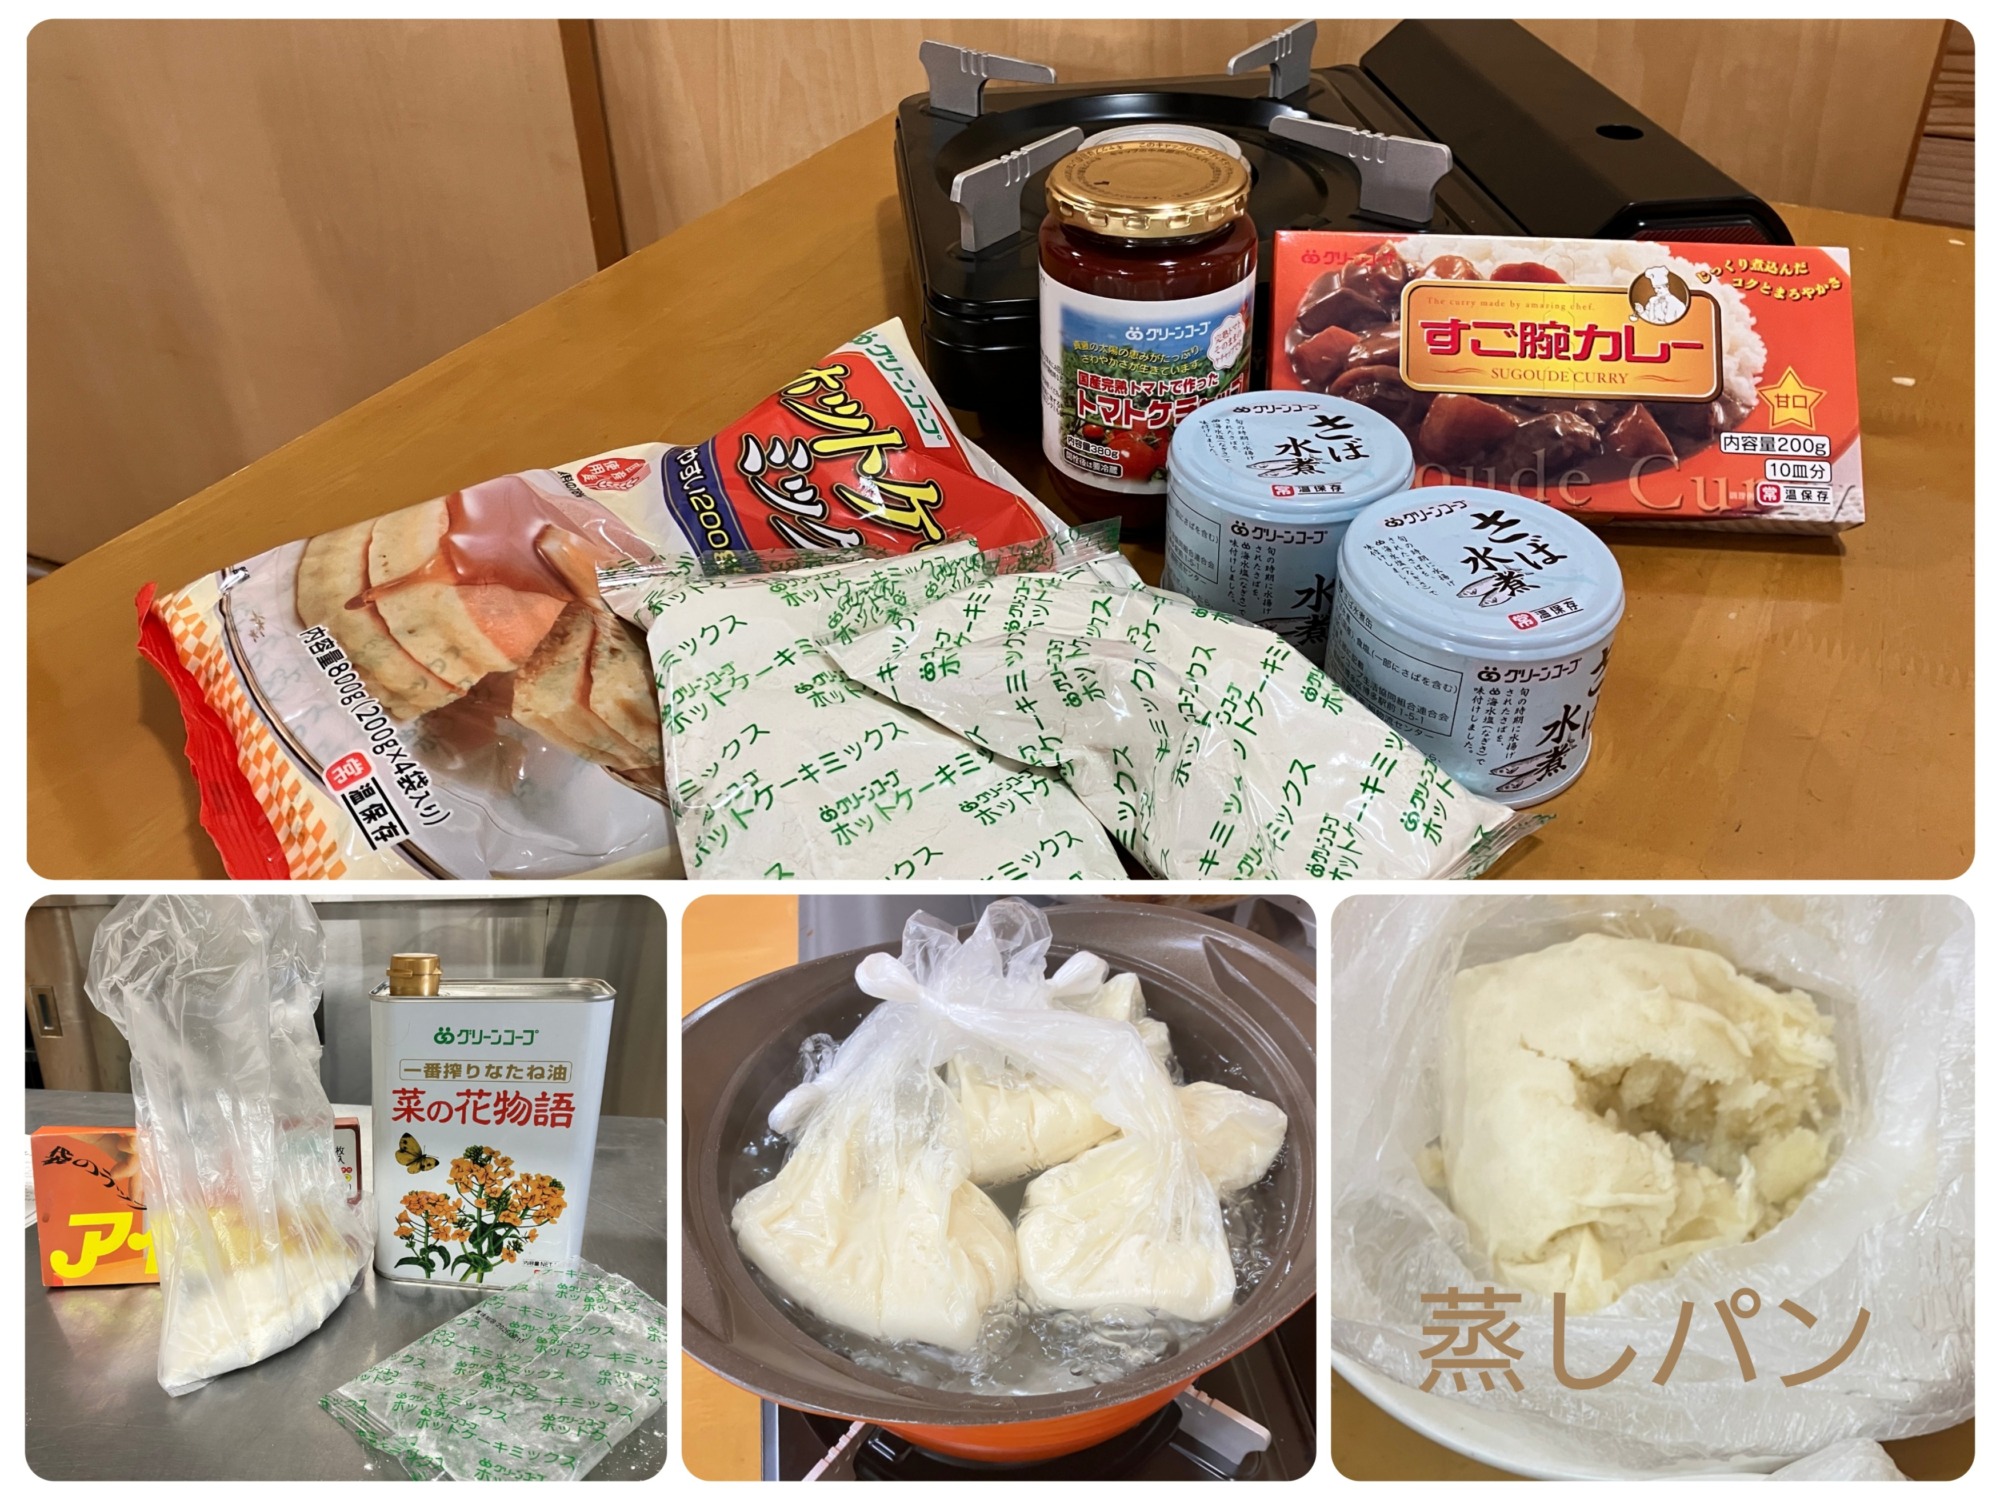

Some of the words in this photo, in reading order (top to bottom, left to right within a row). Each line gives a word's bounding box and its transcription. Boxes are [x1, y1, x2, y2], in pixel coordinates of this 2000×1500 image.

[1696, 258, 1809, 284] じっくり煮込んだ
[1732, 277, 1843, 301] コクとまろやかさ
[1427, 297, 1446, 306] The
[1449, 299, 1477, 309] curry
[1480, 299, 1507, 308] made
[1509, 300, 1521, 310] by
[1525, 301, 1567, 311] amazing
[1145, 321, 1212, 341] グリーンコープ
[1420, 317, 1705, 364] すご腕カレー
[866, 342, 943, 441] グリーンコープ
[1077, 369, 1220, 397] 国産完熟トマトで作った
[1491, 368, 1570, 383] SUGOUDE
[1573, 371, 1629, 385] CURRY
[1252, 404, 1320, 414] グリーンコープ
[1775, 394, 1808, 409] 甘口
[780, 363, 944, 550] ホットケ
[1066, 435, 1120, 459] 内容量380g
[1274, 436, 1327, 476] 水煮
[1306, 415, 1370, 463] さば
[1723, 434, 1827, 456] 内容量200g
[738, 432, 864, 551] ミック
[1414, 448, 1592, 506] oude
[1628, 453, 1759, 515] Cur
[1760, 484, 1829, 503] 常温保存
[1770, 462, 1826, 480] 10皿分
[1403, 499, 1469, 524] グリーンコープ
[1252, 526, 1328, 545] グリーンコープ
[1469, 509, 1569, 571] さば
[1262, 545, 1276, 615] 旬の時期に水揚げ
[1460, 546, 1541, 597] 水煮
[1507, 599, 1580, 631] 常温保存
[1503, 657, 1583, 684] グリーンコープ
[299, 625, 452, 827] 内容量800g(200g×4袋入り)
[1130, 657, 1171, 764] キミックス
[1463, 686, 1486, 755] 味付けしました。
[1496, 688, 1515, 747] されたさばを、
[1505, 686, 1530, 760] 旬の時期に水揚げ
[1536, 703, 1582, 783] 水煮
[331, 755, 401, 844] 常温保存
[836, 768, 902, 816] グリーンコープ
[1328, 730, 1404, 880] ホットケーキミッ
[1422, 777, 1456, 847] ホット
[996, 829, 1084, 880] ミックス
[456, 1028, 539, 1046] グリーンコープ
[403, 1061, 569, 1082] 一番搾りなたね油
[391, 1087, 576, 1129] 菜の花物語
[50, 1211, 159, 1279] アイ
